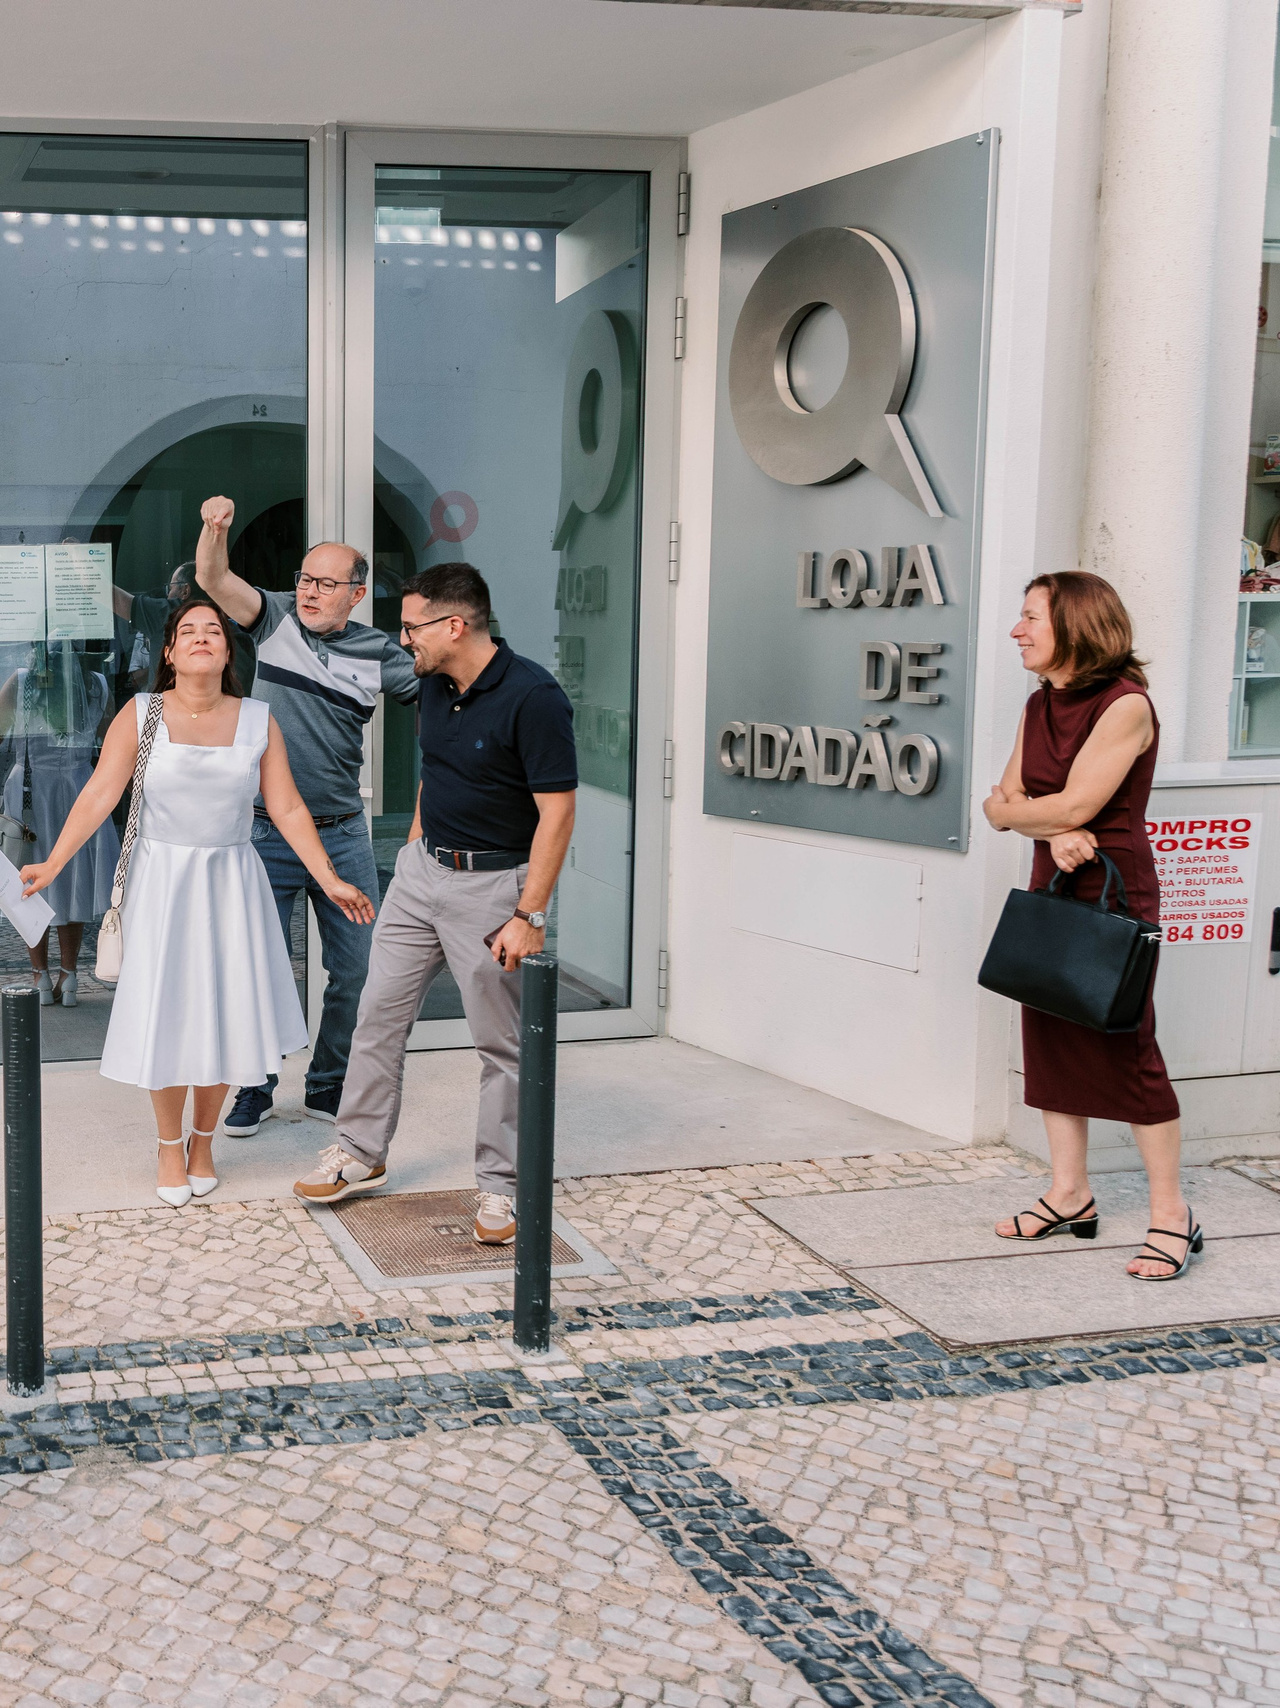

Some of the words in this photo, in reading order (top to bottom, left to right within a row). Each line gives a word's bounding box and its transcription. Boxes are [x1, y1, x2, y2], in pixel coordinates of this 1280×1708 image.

[796, 544, 944, 608] LOJA
[859, 640, 942, 704] DE
[717, 714, 938, 796] CIDADÃO
[1145, 818, 1252, 836] OMPRO
[1149, 836, 1250, 852] OCKS
[1176, 855, 1229, 865] SAPATOS
[1176, 866, 1238, 875] PERFUMES
[1185, 876, 1244, 886] BIJUTARIA
[1170, 900, 1206, 908] COISAS
[1209, 898, 1248, 906] USADAS
[1201, 911, 1246, 920] USADOS
[1201, 923, 1244, 940] 809
